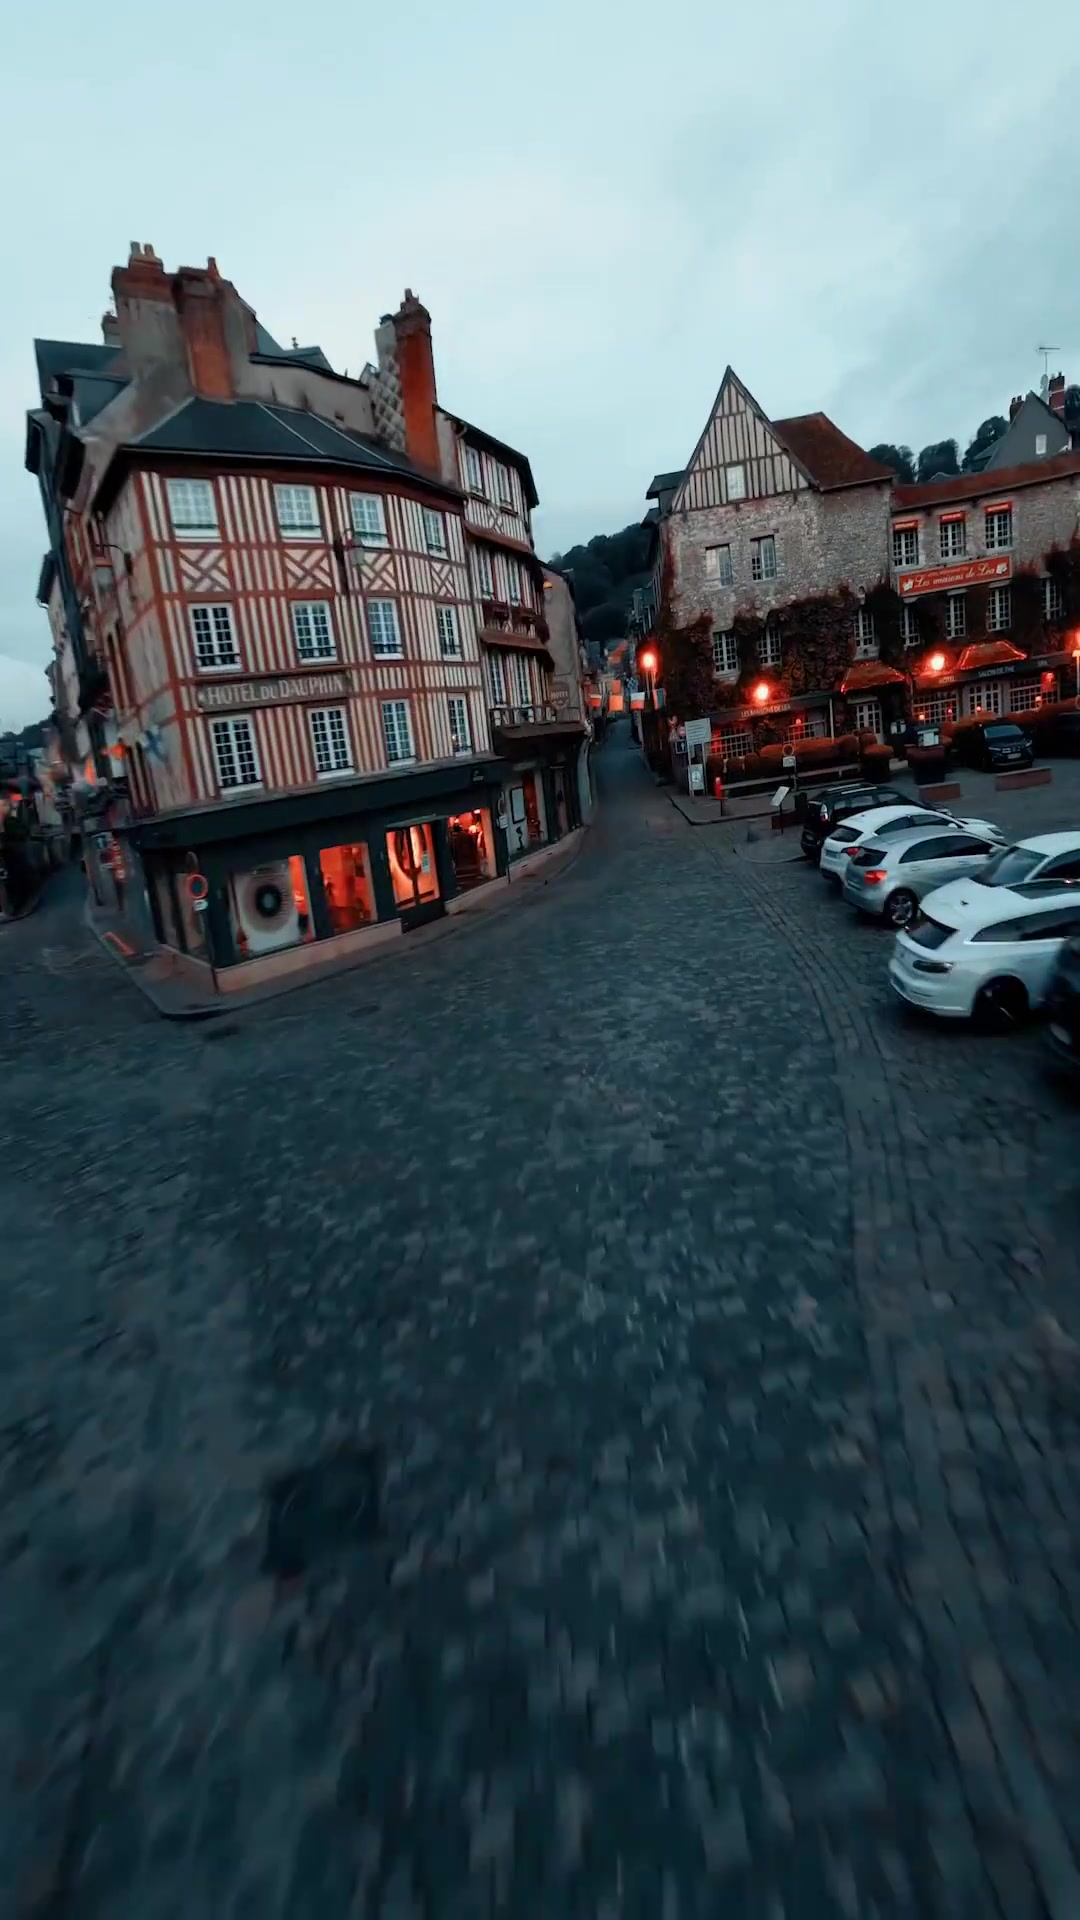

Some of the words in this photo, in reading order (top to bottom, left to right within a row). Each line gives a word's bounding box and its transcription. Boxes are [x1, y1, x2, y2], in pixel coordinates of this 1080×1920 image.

[208, 683, 260, 705] HOTEL
[261, 685, 278, 700] DU
[279, 674, 343, 698] DAUPHIN
